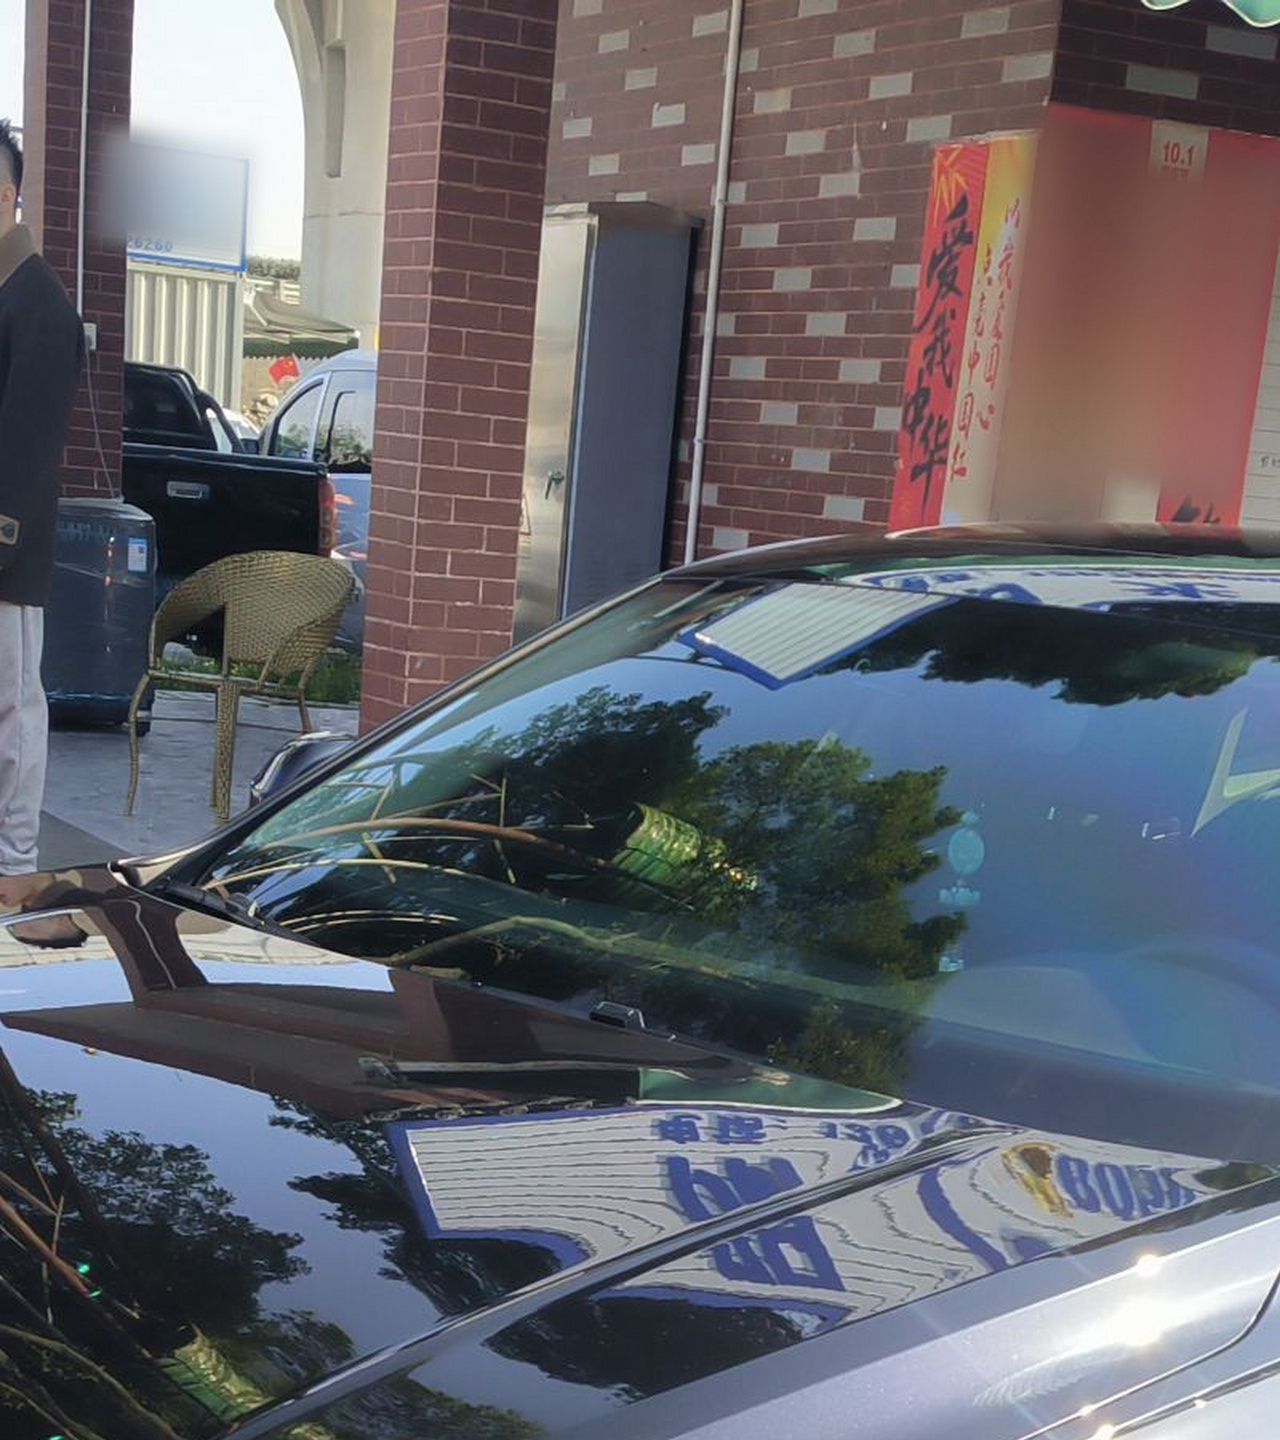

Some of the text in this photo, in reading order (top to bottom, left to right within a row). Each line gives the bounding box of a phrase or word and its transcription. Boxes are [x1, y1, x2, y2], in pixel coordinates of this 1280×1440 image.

[1163, 141, 1195, 167] 10.1
[901, 193, 974, 508] 爱我中华
